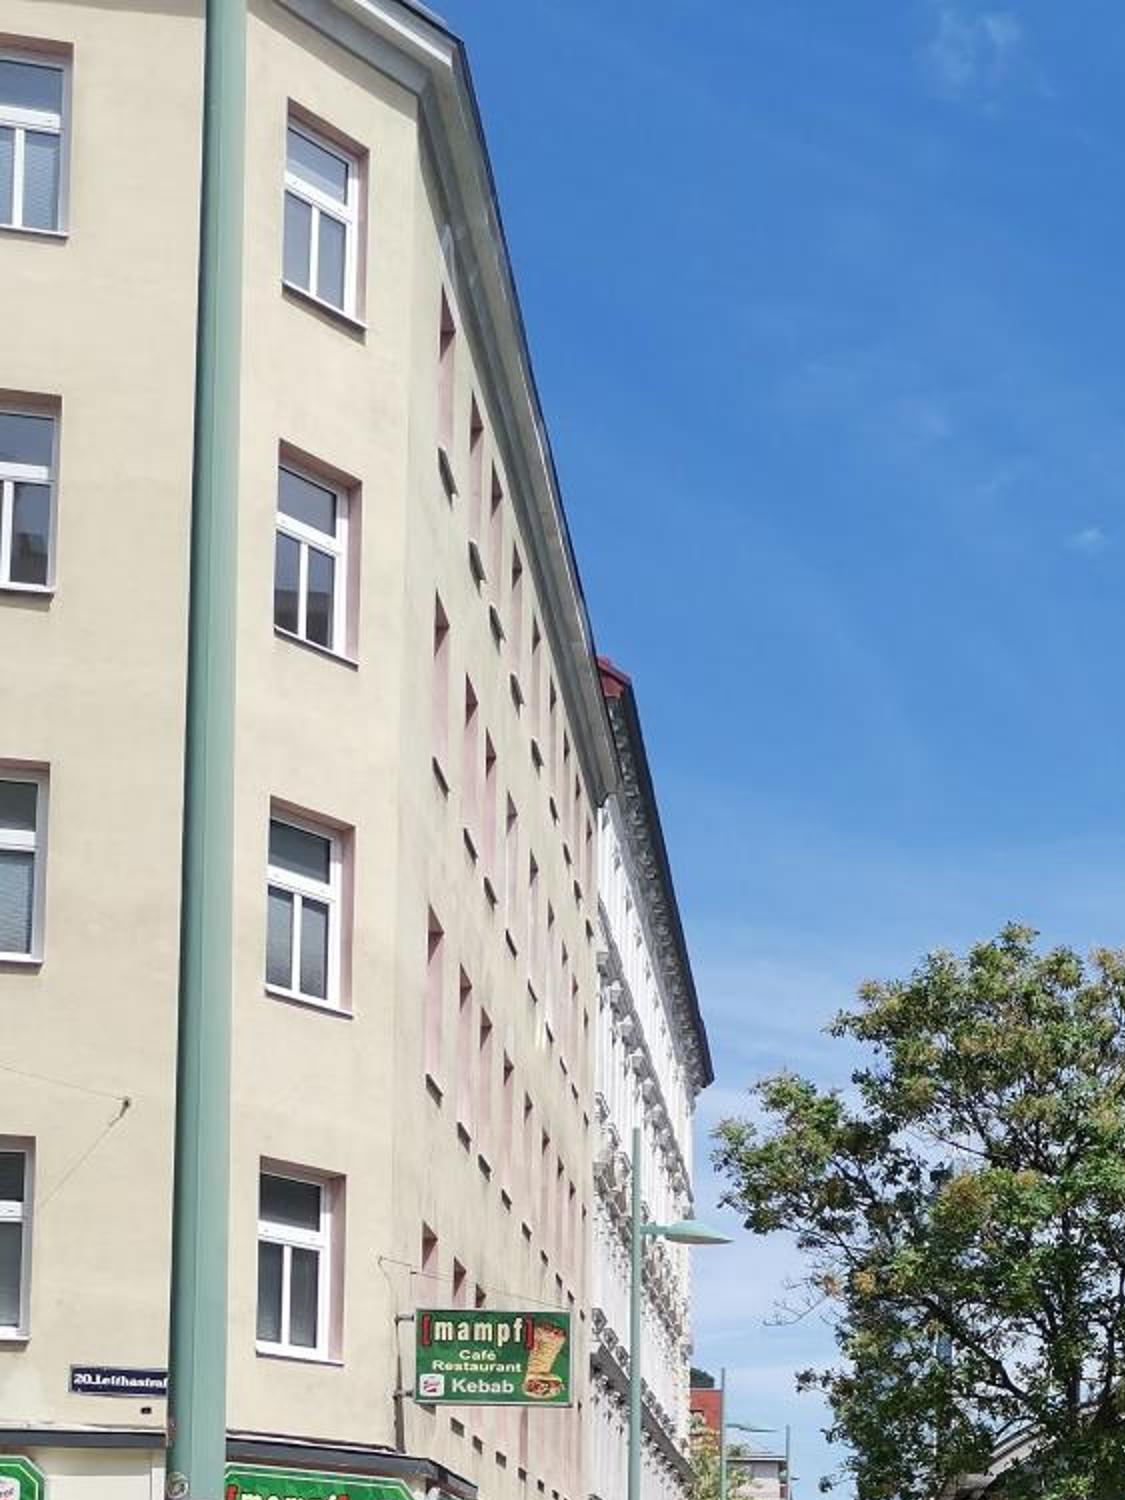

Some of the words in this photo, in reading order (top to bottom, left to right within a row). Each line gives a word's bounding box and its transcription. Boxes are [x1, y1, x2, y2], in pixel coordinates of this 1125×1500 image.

[459, 1349, 497, 1361] Café
[431, 1360, 523, 1373] Restaurant
[451, 1378, 515, 1394] Kebab
